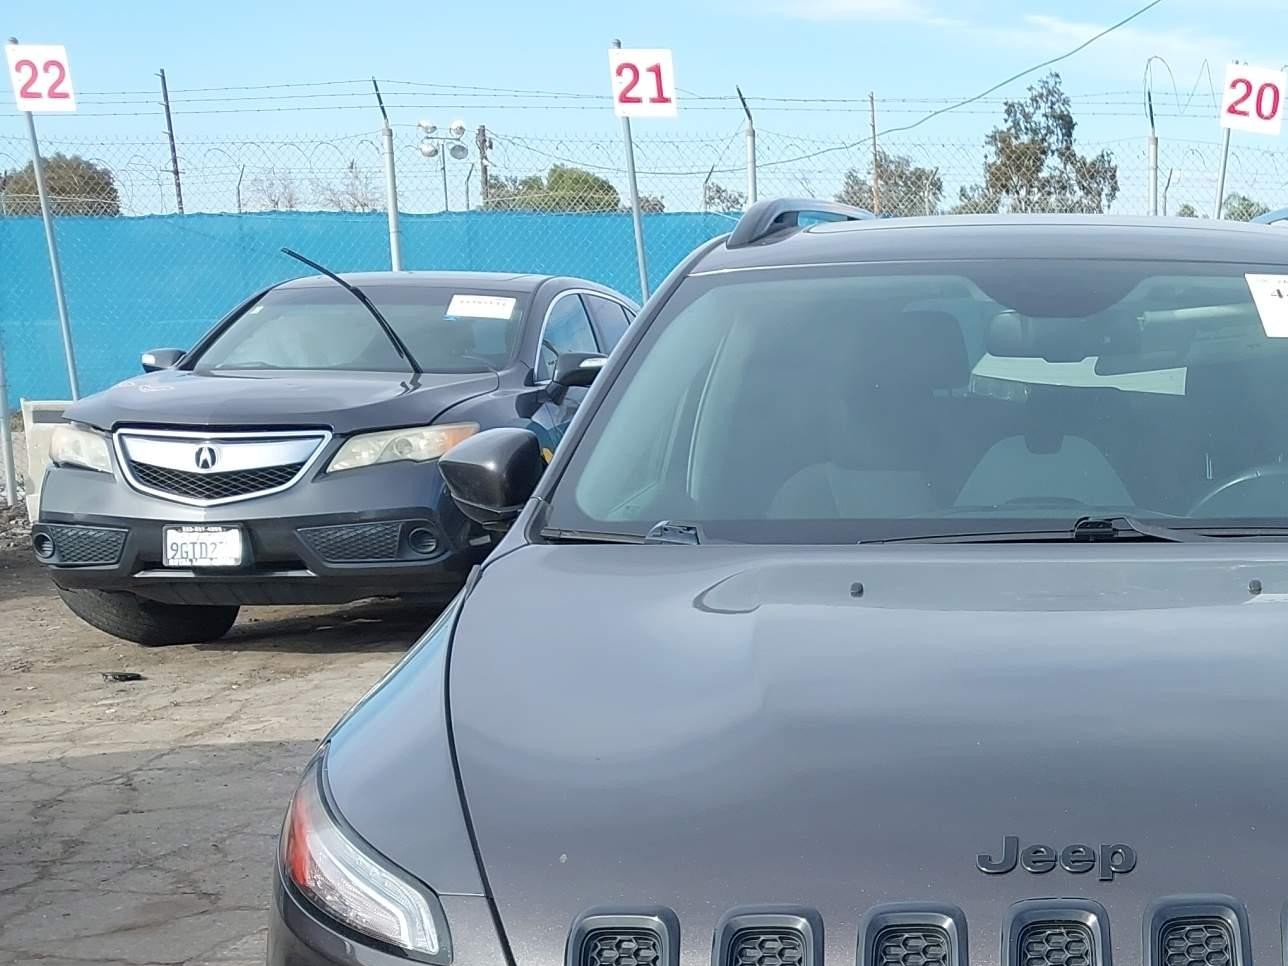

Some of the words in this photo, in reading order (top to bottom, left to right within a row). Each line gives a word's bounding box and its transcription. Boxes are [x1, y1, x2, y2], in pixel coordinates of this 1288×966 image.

[14, 58, 71, 101] 22
[614, 62, 673, 105] 21
[1226, 78, 1281, 121] 20
[976, 834, 1137, 882] Jeep
